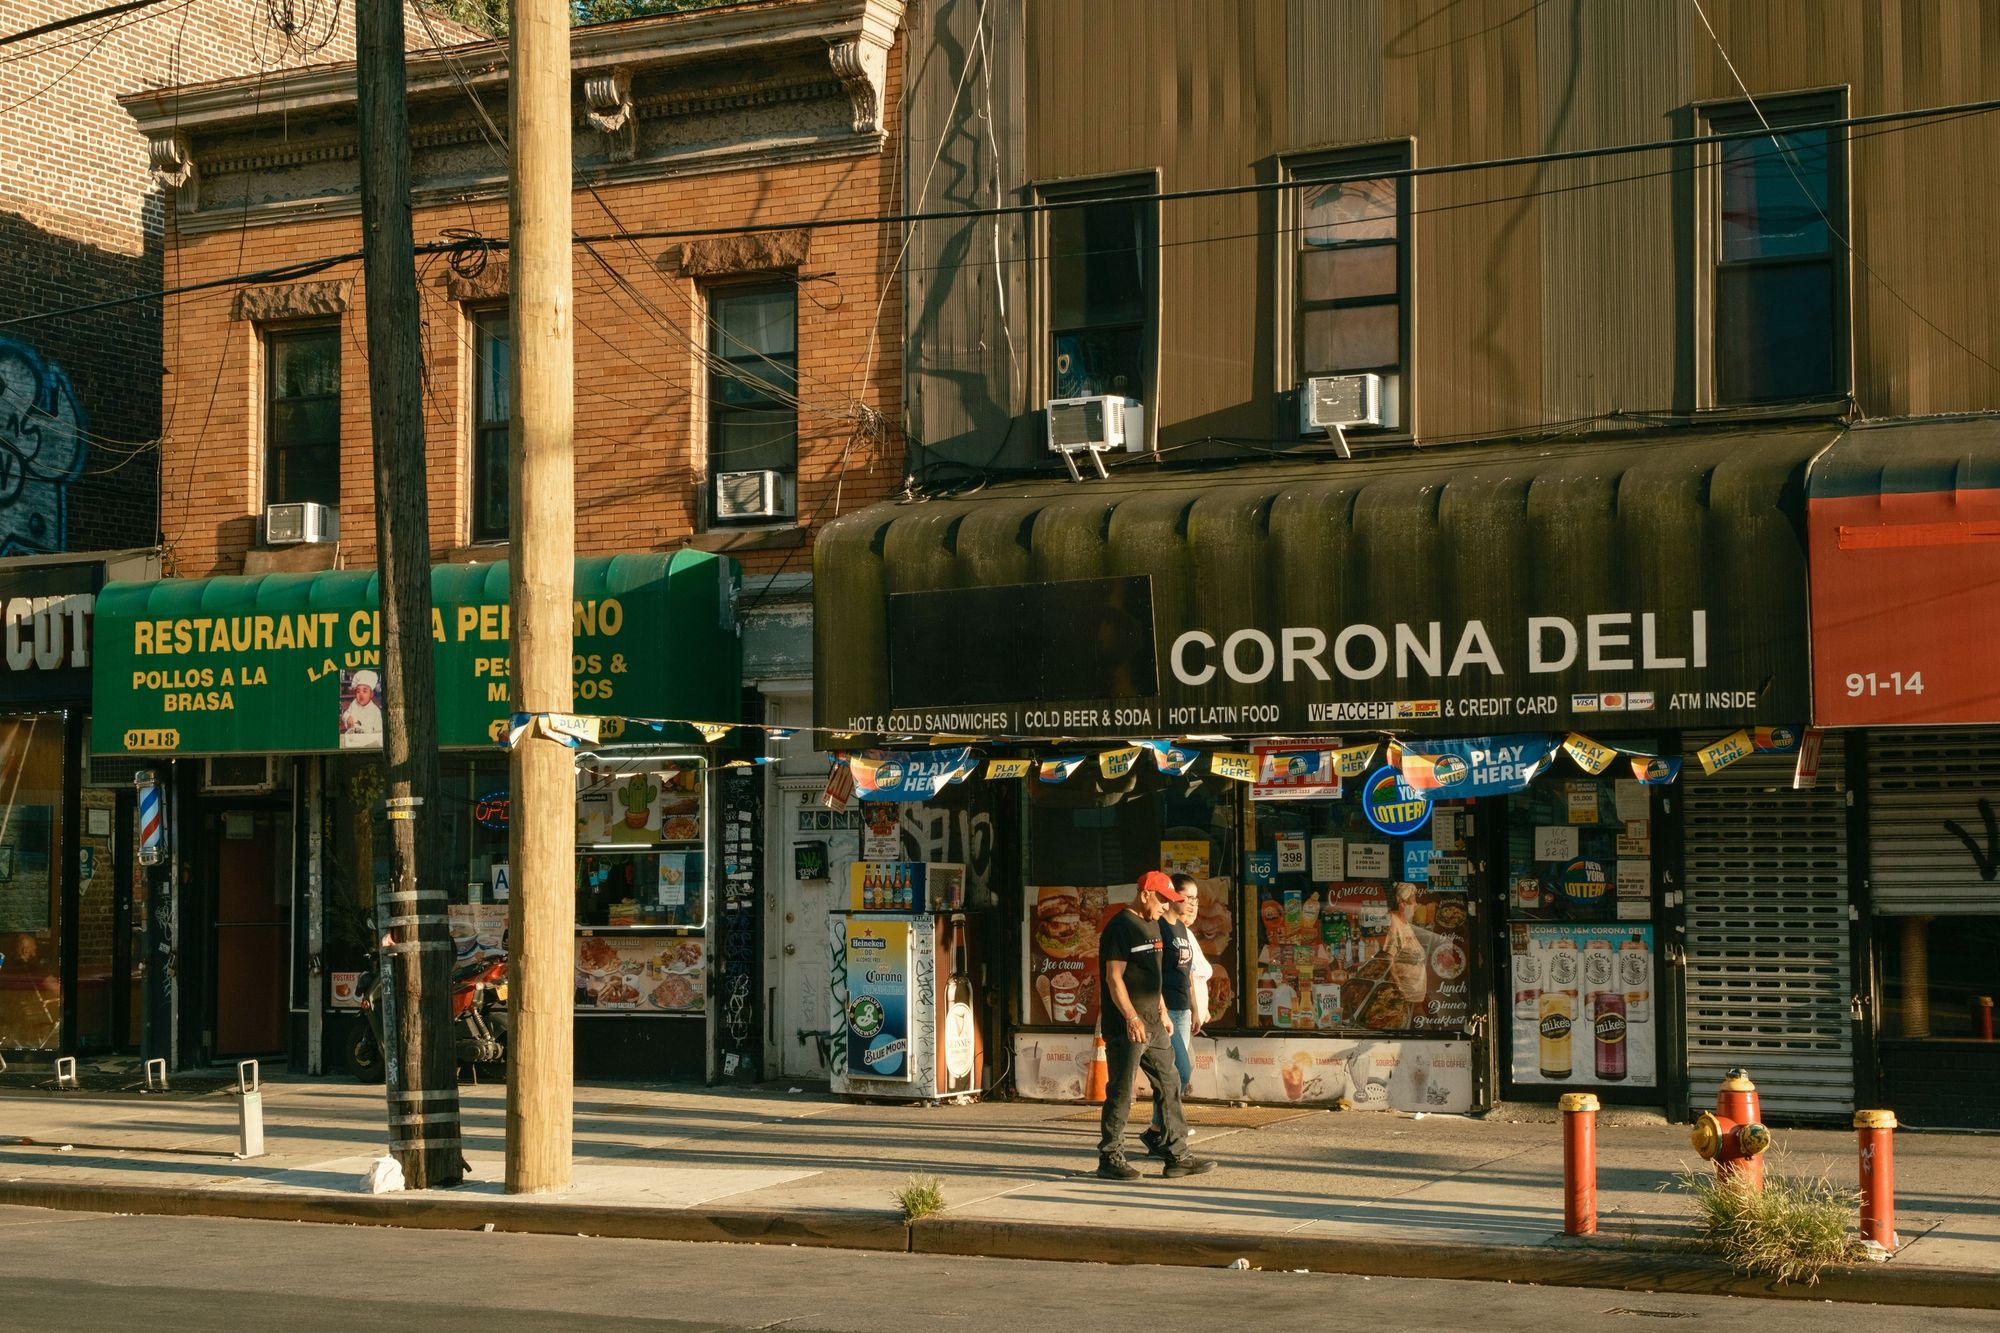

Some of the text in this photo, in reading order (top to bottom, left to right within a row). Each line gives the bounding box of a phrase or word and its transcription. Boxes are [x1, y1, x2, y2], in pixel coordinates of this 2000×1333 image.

[6, 593, 94, 671] CUT
[135, 612, 339, 655] RESTAURANT
[1170, 610, 1707, 686] CORONA DELI
[307, 658, 338, 682] LA
[610, 653, 628, 674] &
[133, 667, 268, 690] POLLOS A LA
[1845, 671, 1924, 697] 91-14
[163, 691, 234, 712] BRASA
[1311, 704, 1332, 720] WE
[1337, 703, 1393, 719] ACCEPT
[1445, 700, 1454, 717] &
[1459, 697, 1514, 716] CREDIT
[1516, 695, 1558, 714] CARD
[1669, 693, 1701, 710] ATM
[1705, 691, 1756, 709] INSIDE
[848, 704, 1279, 733] HOT & COLD SANDWICHES COLD BEER & SODA HOT LATIN FOOD
[127, 732, 174, 747] 91-18
[1341, 751, 1369, 762] PLAY
[1470, 745, 1524, 767] PLAY
[1575, 741, 1604, 759] PLAY
[1708, 738, 1737, 760] PLAY
[1108, 752, 1133, 764] PLAY
[1221, 758, 1249, 767] PLAY
[908, 762, 950, 776] PLAY
[995, 764, 1020, 772] PLAY
[1109, 763, 1129, 774] HER
[1341, 762, 1366, 773] HER
[1473, 763, 1527, 785] HERE
[904, 777, 935, 792] HER
[475, 800, 510, 821] OPE
[1372, 801, 1426, 823] LOTTERY
[495, 869, 508, 889] A
[1586, 870, 1605, 882] YORK
[1328, 886, 1378, 906] Cervezas
[1564, 882, 1606, 898] LOTTERY
[1591, 927, 1626, 935] CORONA
[852, 939, 885, 947] Heineken
[1058, 959, 1085, 970] cream
[865, 970, 902, 983] Corona
[1436, 981, 1467, 997] Lunch
[852, 995, 881, 1009] BROOKLYN
[1428, 999, 1467, 1014] Dinner
[1413, 1014, 1467, 1028] Breakfast
[1541, 1019, 1570, 1032] mike's
[1596, 1020, 1625, 1034] mike's
[852, 1023, 880, 1036] BREWERY
[864, 1040, 906, 1064] BLUE MOON
[1046, 1053, 1072, 1062] OATMEAL
[1432, 1060, 1466, 1068] ICED COFFEE
